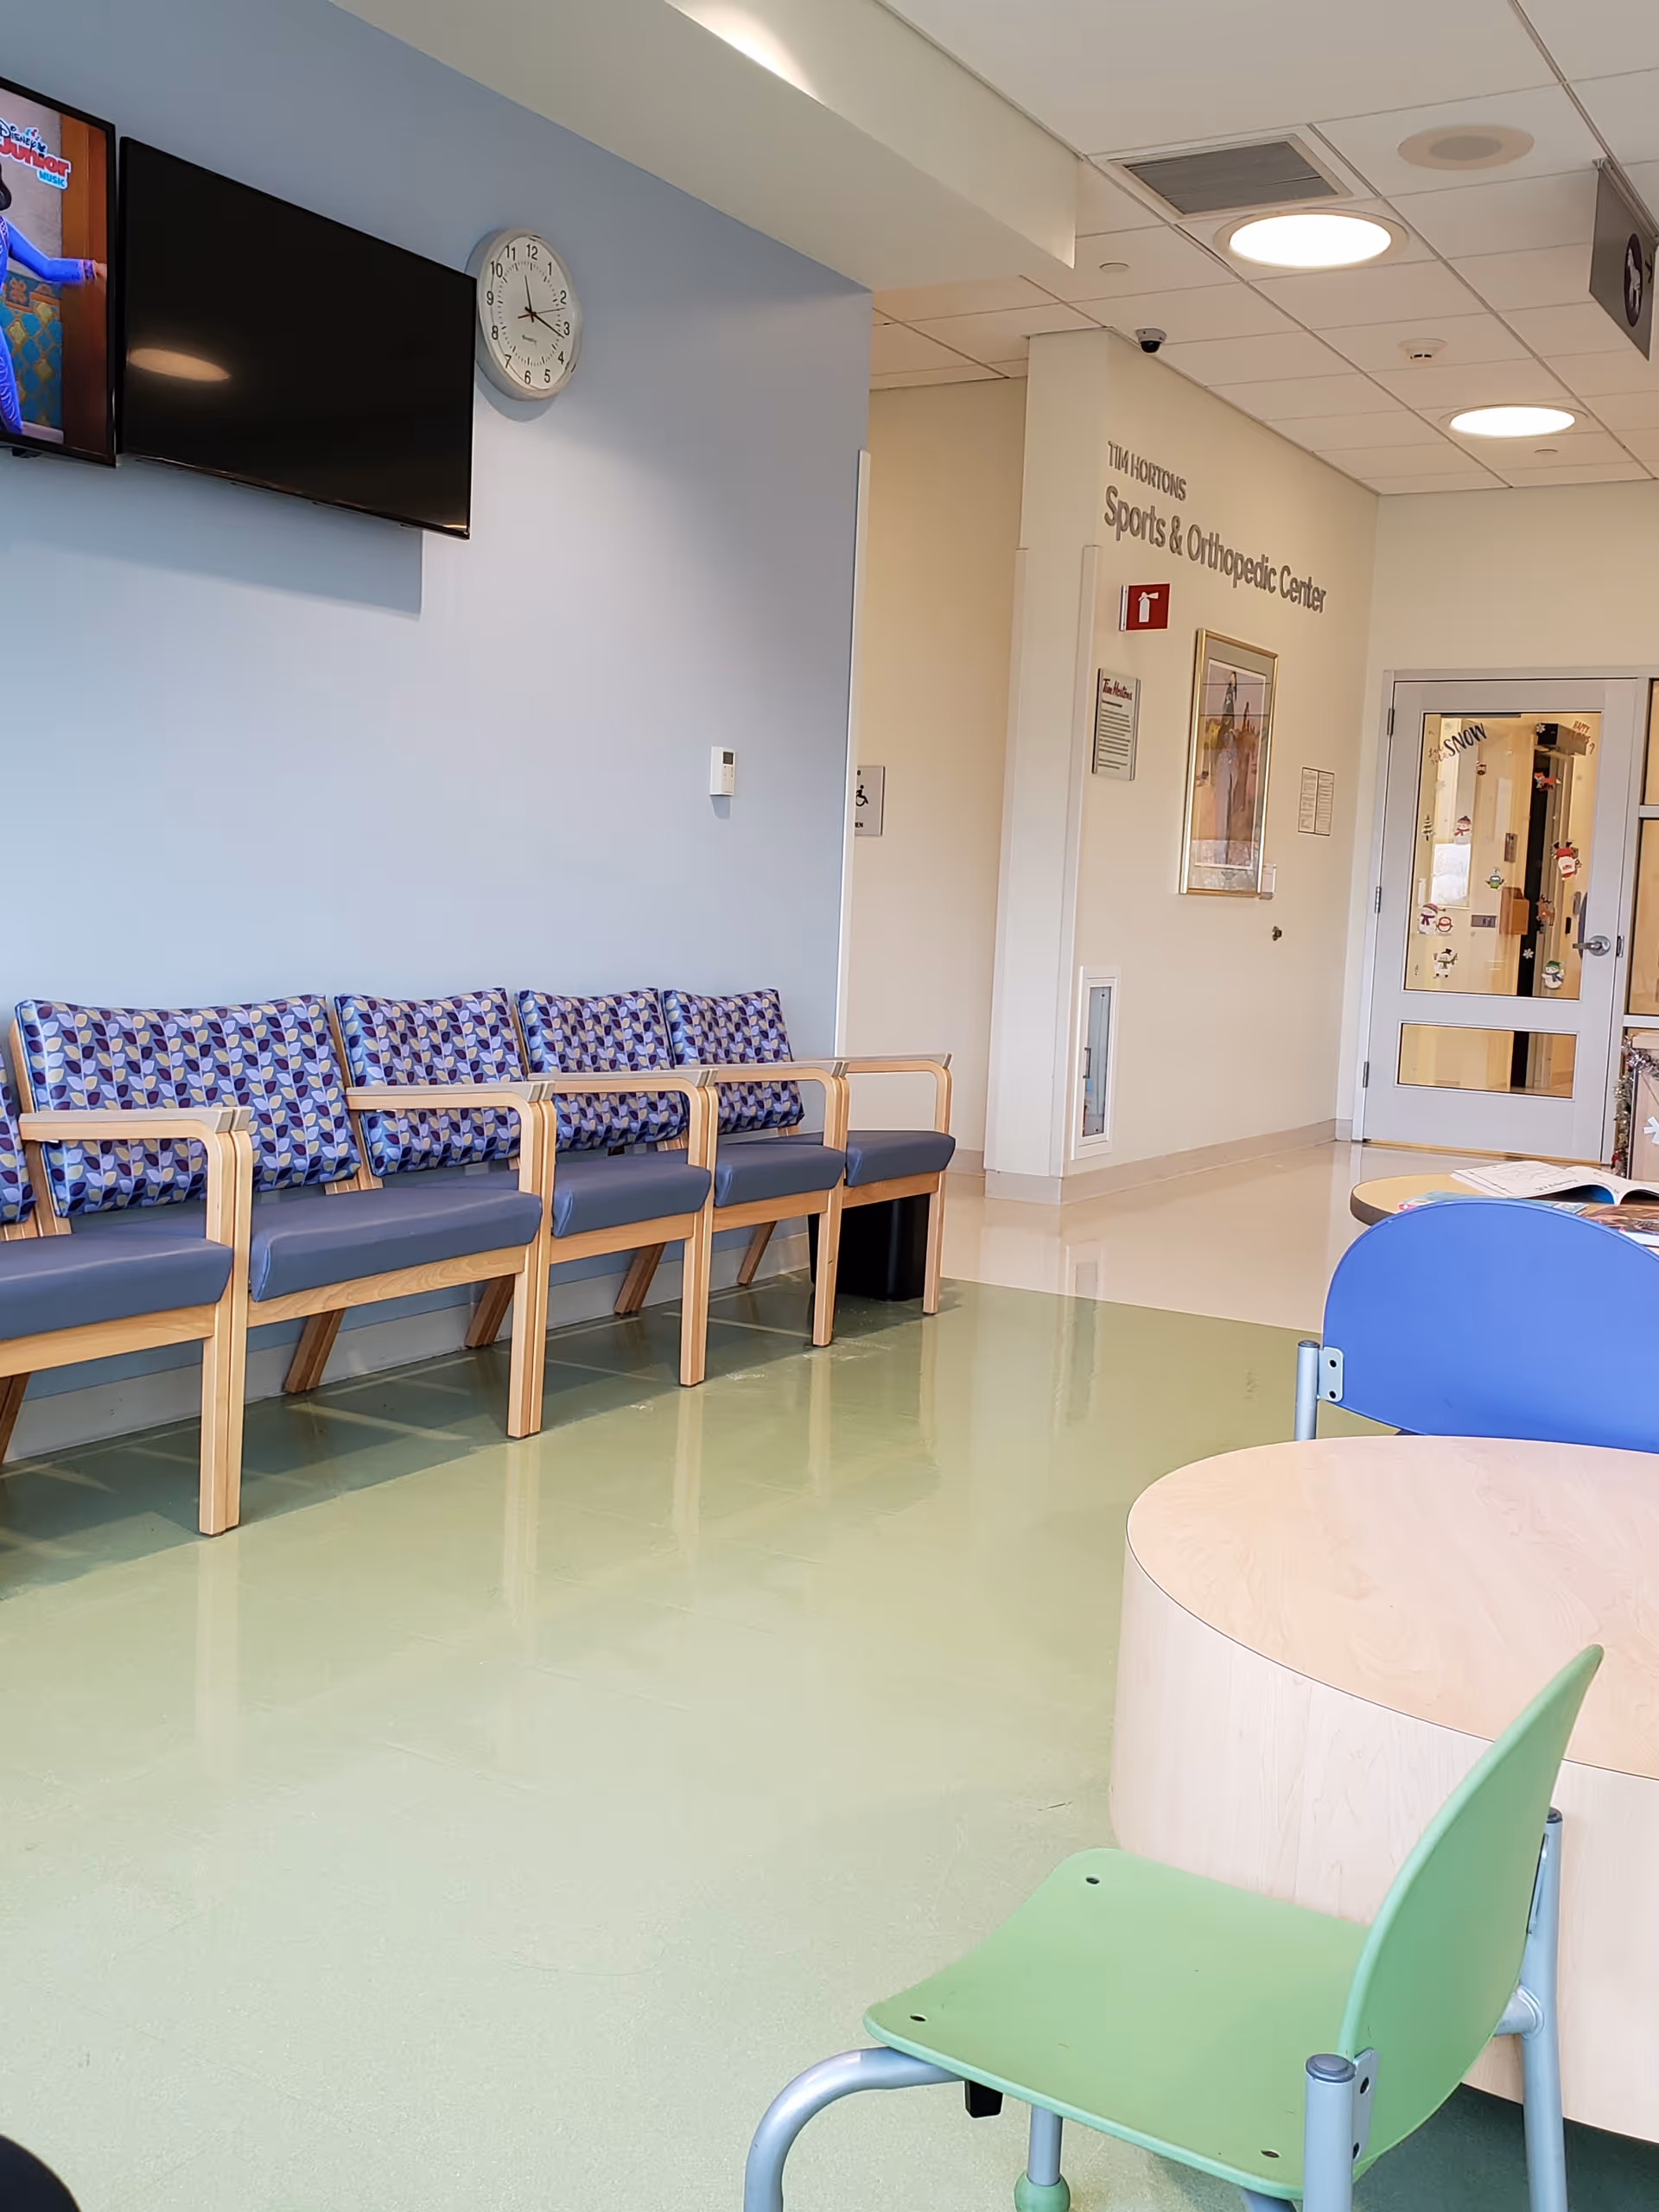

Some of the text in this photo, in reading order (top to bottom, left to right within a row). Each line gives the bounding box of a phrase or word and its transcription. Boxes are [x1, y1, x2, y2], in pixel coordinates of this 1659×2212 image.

[39, 170, 66, 188] MUSIC
[505, 245, 517, 261] 11
[526, 244, 538, 260] 12
[491, 261, 504, 278] 10
[547, 262, 553, 276] 1
[486, 290, 494, 306] 9
[560, 290, 567, 305] 2
[492, 325, 499, 340] 8
[563, 321, 570, 336] 3
[504, 354, 512, 369] 7
[557, 351, 565, 365] 4
[524, 371, 532, 385] 6
[543, 369, 551, 384] 5
[1108, 440, 1186, 501] TIM HORTONS
[1103, 485, 1327, 613] Sports & Orthopedic Center
[1443, 722, 1487, 757] SNOW
